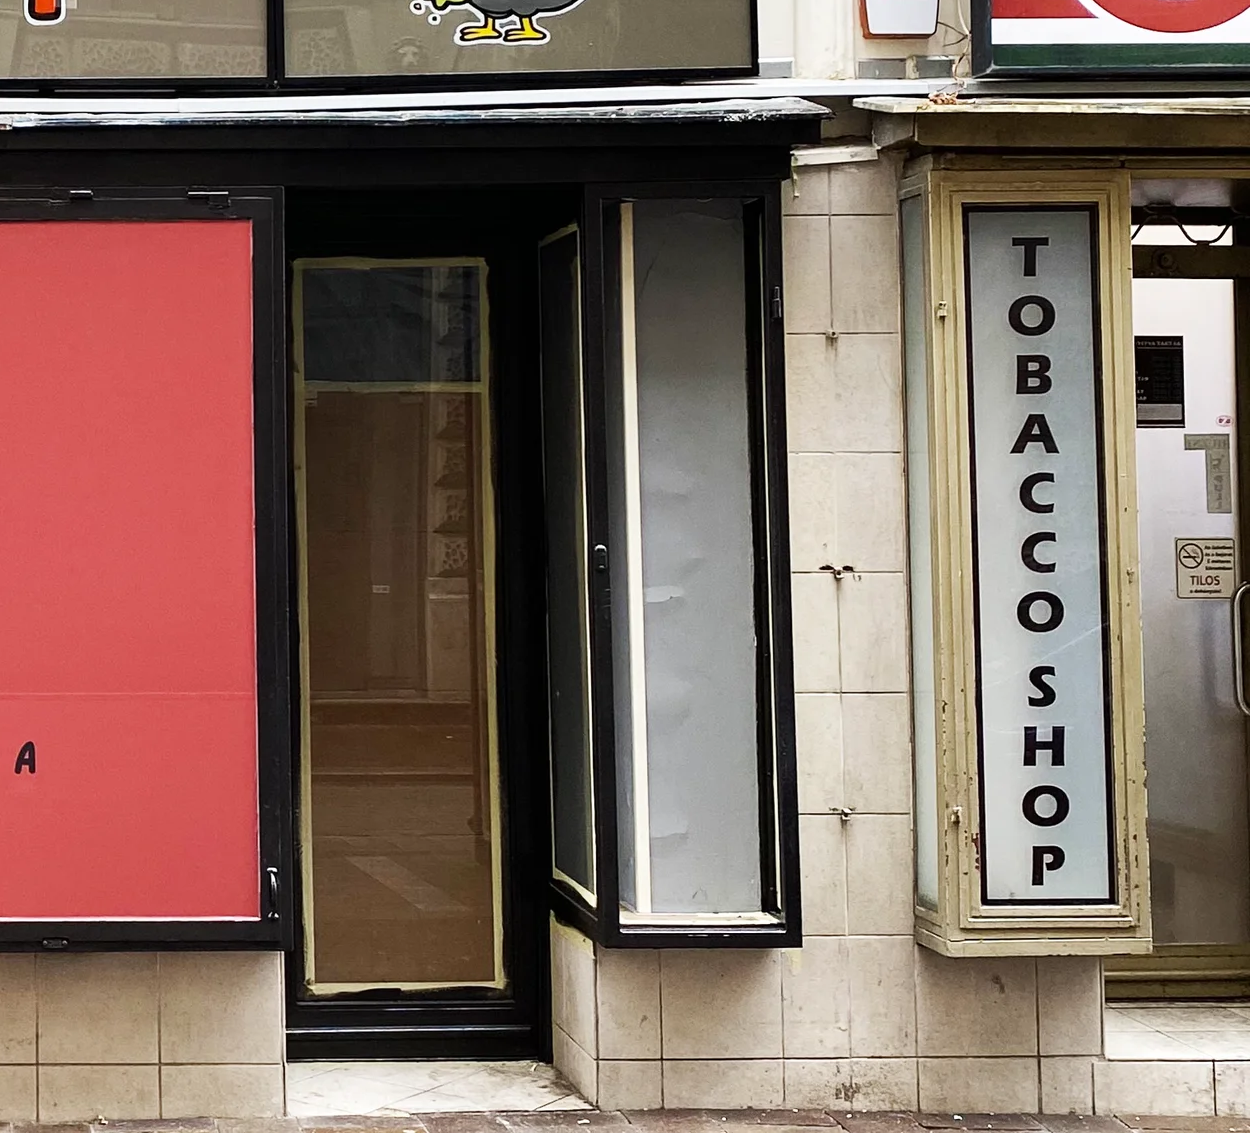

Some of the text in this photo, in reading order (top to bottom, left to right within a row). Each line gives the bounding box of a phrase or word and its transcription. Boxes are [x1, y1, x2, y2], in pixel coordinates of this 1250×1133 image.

[1008, 236, 1070, 886] TOBACCO SHOP
[1190, 575, 1220, 586] TILOS
[14, 741, 37, 774] A
